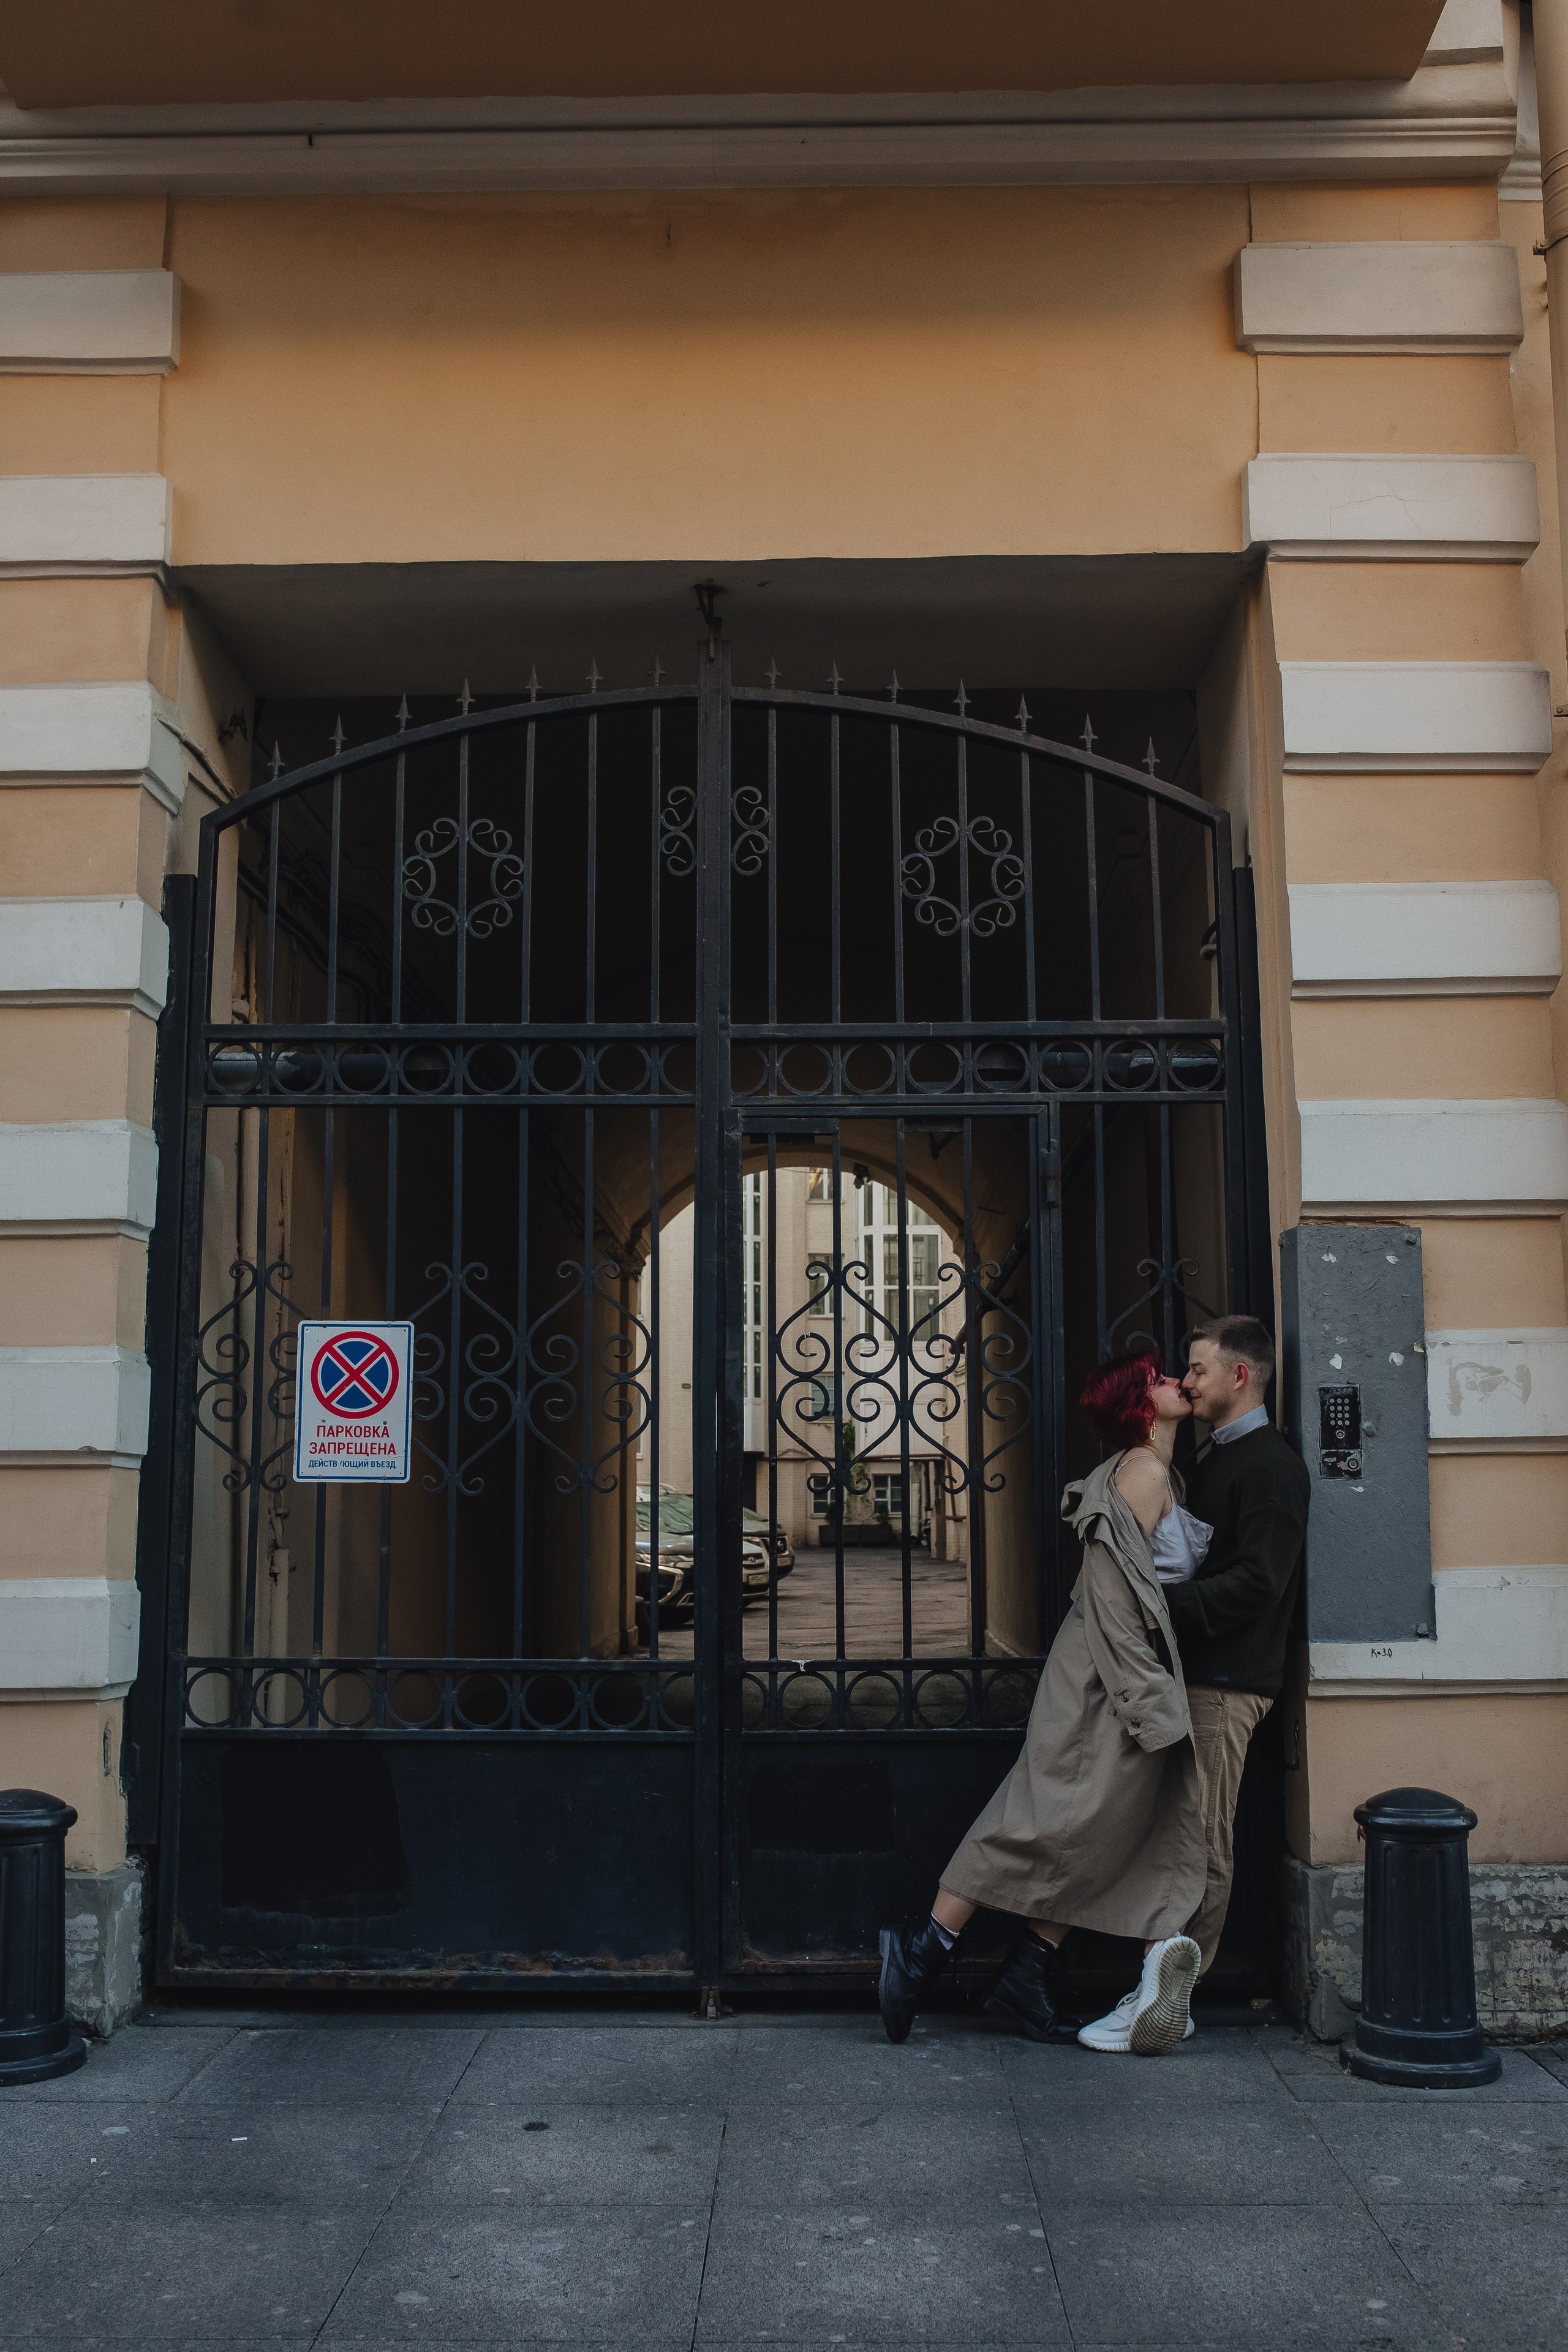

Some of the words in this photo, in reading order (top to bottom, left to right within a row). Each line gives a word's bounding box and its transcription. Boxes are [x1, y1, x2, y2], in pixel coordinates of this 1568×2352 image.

[317, 1425, 390, 1438] ПАРКОВКА
[309, 1442, 396, 1457] ЗАПРЕЩЕНА
[371, 1460, 396, 1469] ВЪЕЗД
